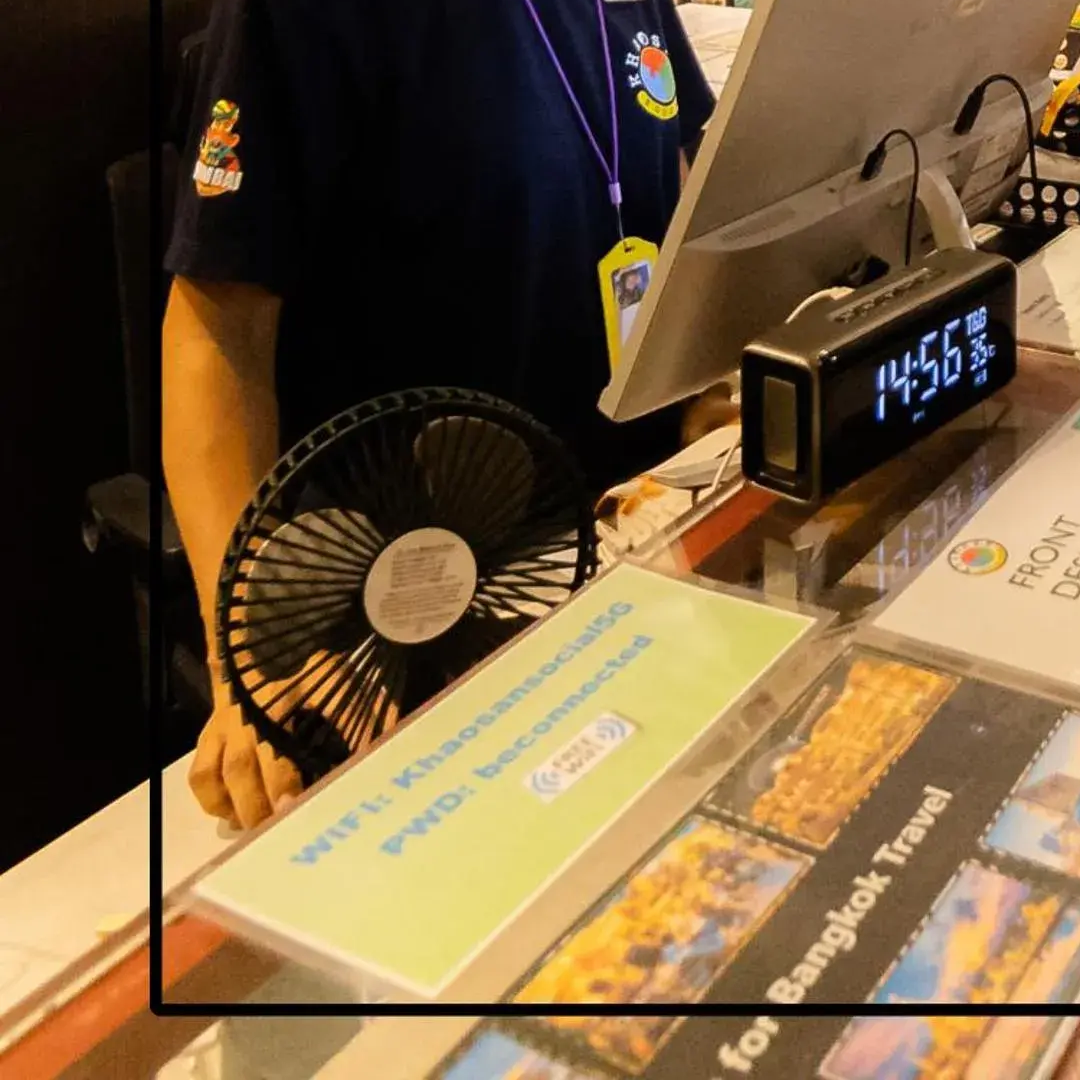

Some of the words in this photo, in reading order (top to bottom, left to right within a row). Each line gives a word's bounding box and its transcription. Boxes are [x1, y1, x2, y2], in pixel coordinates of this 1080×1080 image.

[876, 317, 962, 421] 14:56
[472, 634, 654, 780] beconnected
[717, 1015, 780, 1073] for
[765, 869, 892, 1004] Bangkok
[871, 784, 953, 867] Travel
